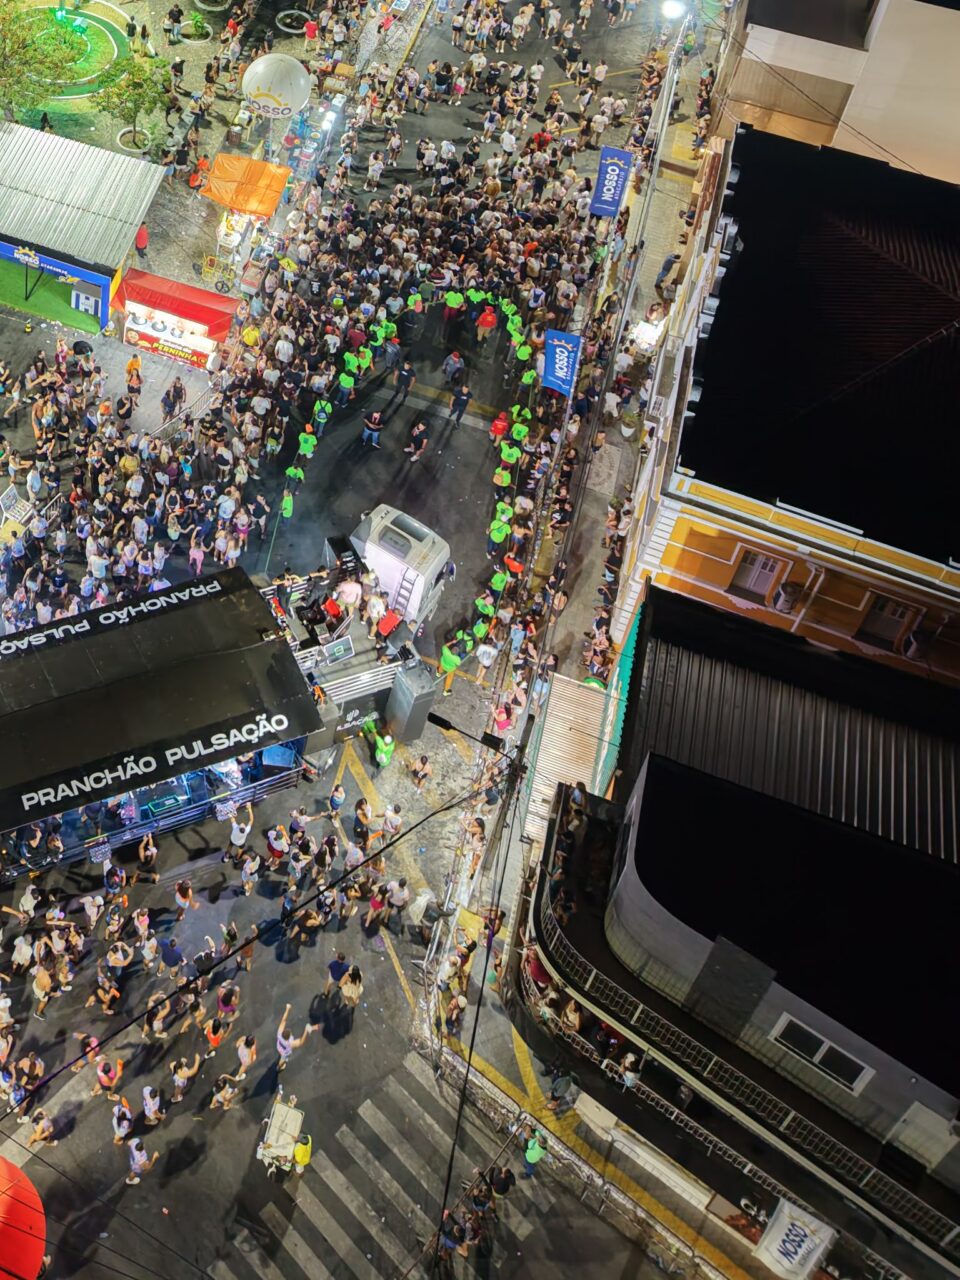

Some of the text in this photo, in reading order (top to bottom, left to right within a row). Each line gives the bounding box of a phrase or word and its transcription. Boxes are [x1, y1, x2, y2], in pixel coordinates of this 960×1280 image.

[601, 165, 620, 202] NOSSO
[152, 341, 199, 362] PERNINHA
[554, 346, 569, 380] NOSSO
[98, 580, 222, 624] PRANCHÃO
[21, 713, 289, 811] PRANCHÃO PULSAÇÃO
[776, 1221, 810, 1265] NOSSO
